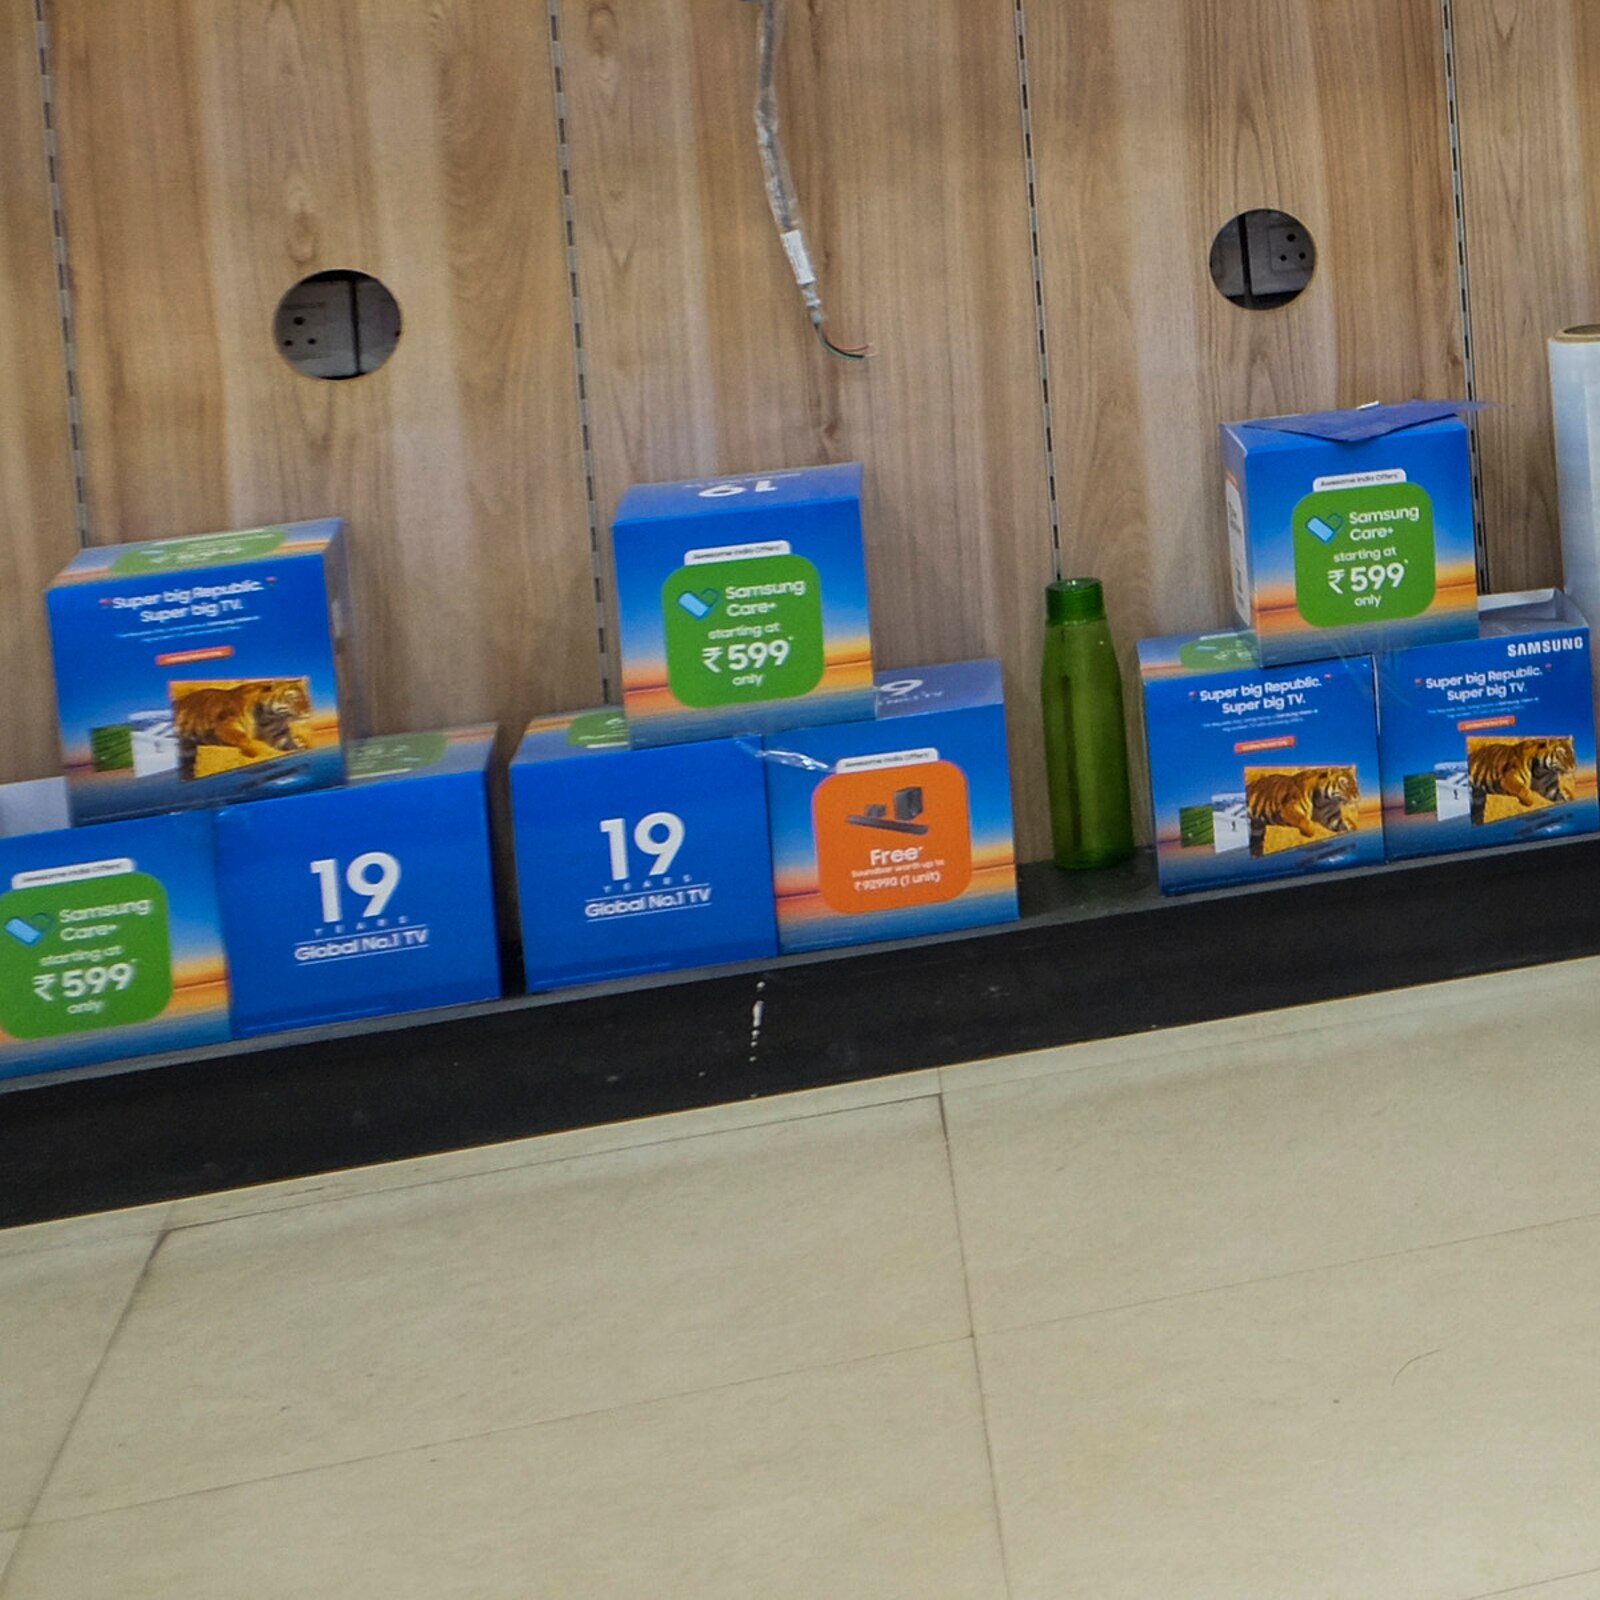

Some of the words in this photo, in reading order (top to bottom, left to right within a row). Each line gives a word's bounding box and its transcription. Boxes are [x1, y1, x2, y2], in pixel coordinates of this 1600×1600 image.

[1319, 478, 1356, 489] Awesome
[1356, 475, 1375, 484] India
[1348, 505, 1420, 525] Samsung
[1349, 525, 1394, 541] Care+
[1333, 548, 1382, 564] starting
[1382, 545, 1398, 556] at
[111, 592, 162, 610] Super
[162, 586, 191, 605] big
[724, 579, 807, 601] Samsung
[725, 601, 778, 617] Care+
[1353, 594, 1382, 608] only
[139, 602, 189, 623] Super
[190, 600, 219, 617] big
[707, 624, 762, 641] starting
[763, 621, 781, 634] at
[1506, 635, 1584, 658] SAMSUNG
[731, 673, 765, 688] only
[1425, 676, 1464, 691] Super
[1464, 671, 1487, 687] big
[1487, 664, 1544, 683] Republic.
[1199, 685, 1240, 704] Super
[1240, 682, 1264, 699] big
[1264, 675, 1323, 695] Republic.
[1446, 686, 1484, 703] Super
[1485, 684, 1507, 699] big
[1221, 698, 1261, 716] Super
[1262, 695, 1286, 712] big
[599, 811, 686, 881] 19
[851, 864, 894, 879] Soundbar
[893, 862, 921, 873] worth
[911, 870, 941, 886] unit)
[310, 851, 402, 923] 19
[58, 898, 154, 924] Samsung
[584, 896, 646, 918] Global
[648, 891, 685, 910] No.1
[686, 886, 713, 904] TV
[59, 922, 119, 942] Care+
[293, 938, 359, 962] Global
[361, 933, 400, 952] No.1
[403, 927, 430, 945] TV
[39, 950, 101, 968] starting
[102, 943, 124, 956] at
[66, 1000, 105, 1015] only
